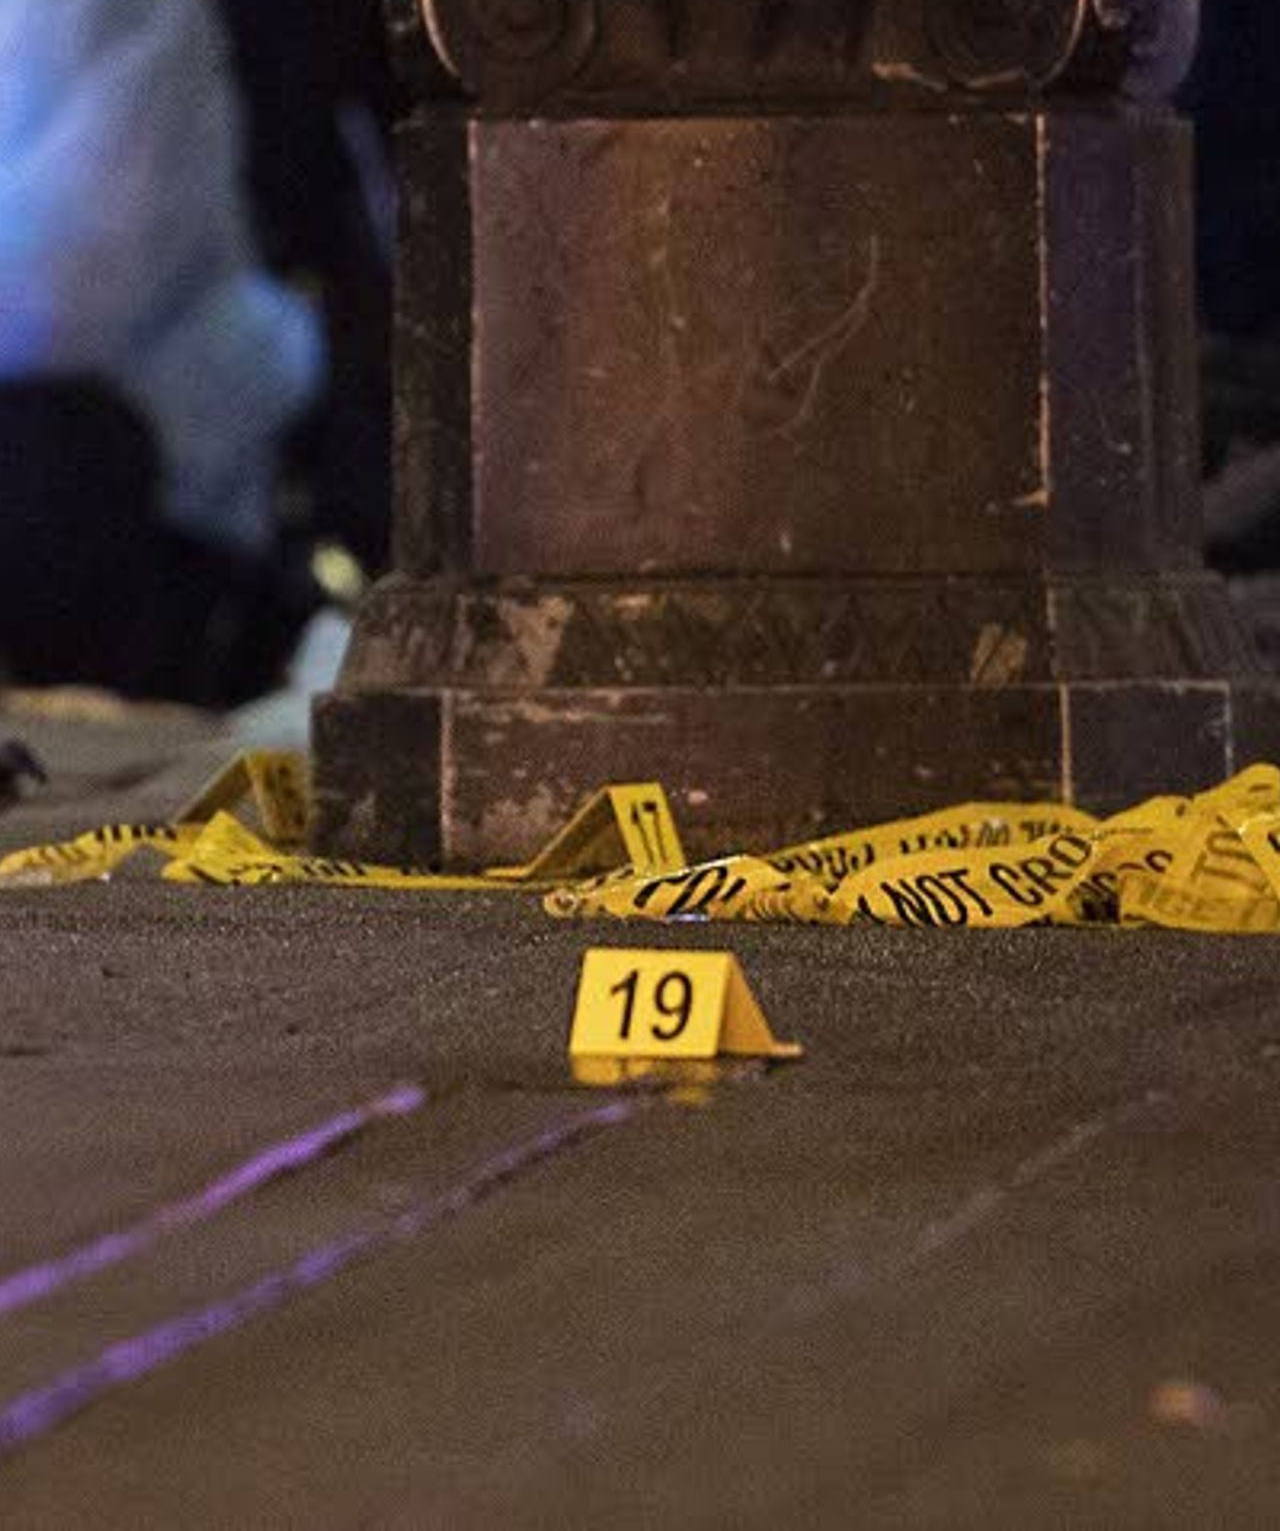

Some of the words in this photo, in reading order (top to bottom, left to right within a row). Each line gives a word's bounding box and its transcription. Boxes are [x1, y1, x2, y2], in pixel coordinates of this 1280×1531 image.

[880, 868, 993, 927] NOT
[987, 833, 1093, 907] CRO
[609, 969, 693, 1042] 19
